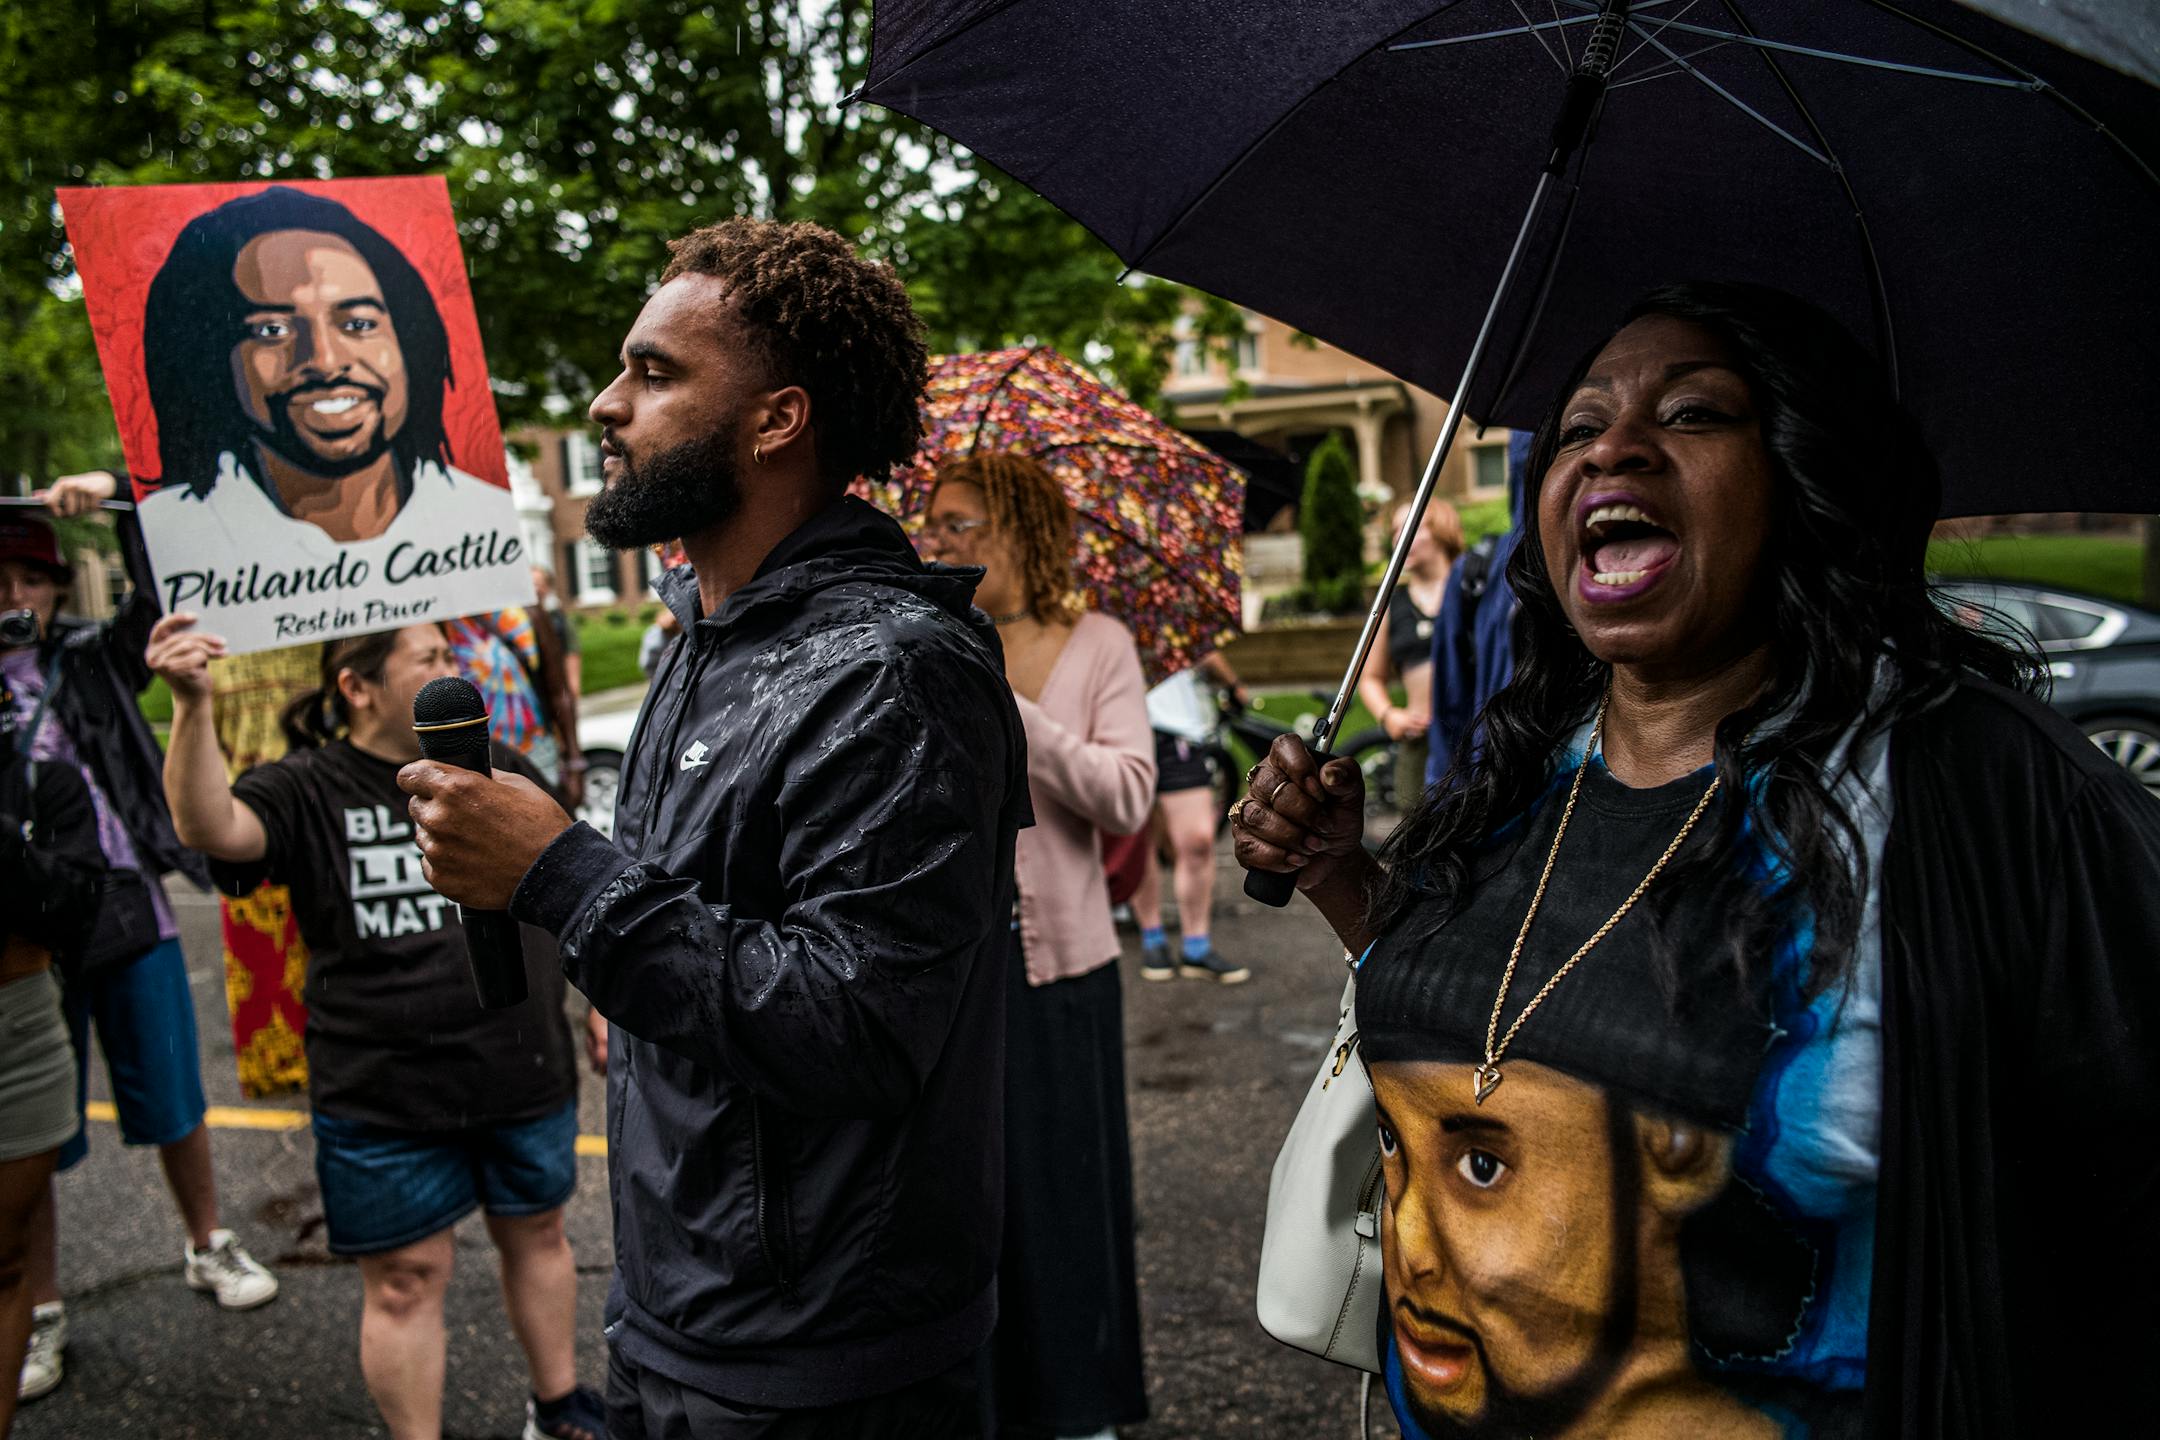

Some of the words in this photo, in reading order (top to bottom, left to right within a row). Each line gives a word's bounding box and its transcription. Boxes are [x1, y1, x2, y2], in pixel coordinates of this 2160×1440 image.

[163, 551, 370, 613] Philando
[384, 530, 522, 585] Castile
[275, 609, 327, 641] Rest
[333, 607, 356, 628] in
[364, 597, 438, 626] Power
[344, 804, 411, 842] BL
